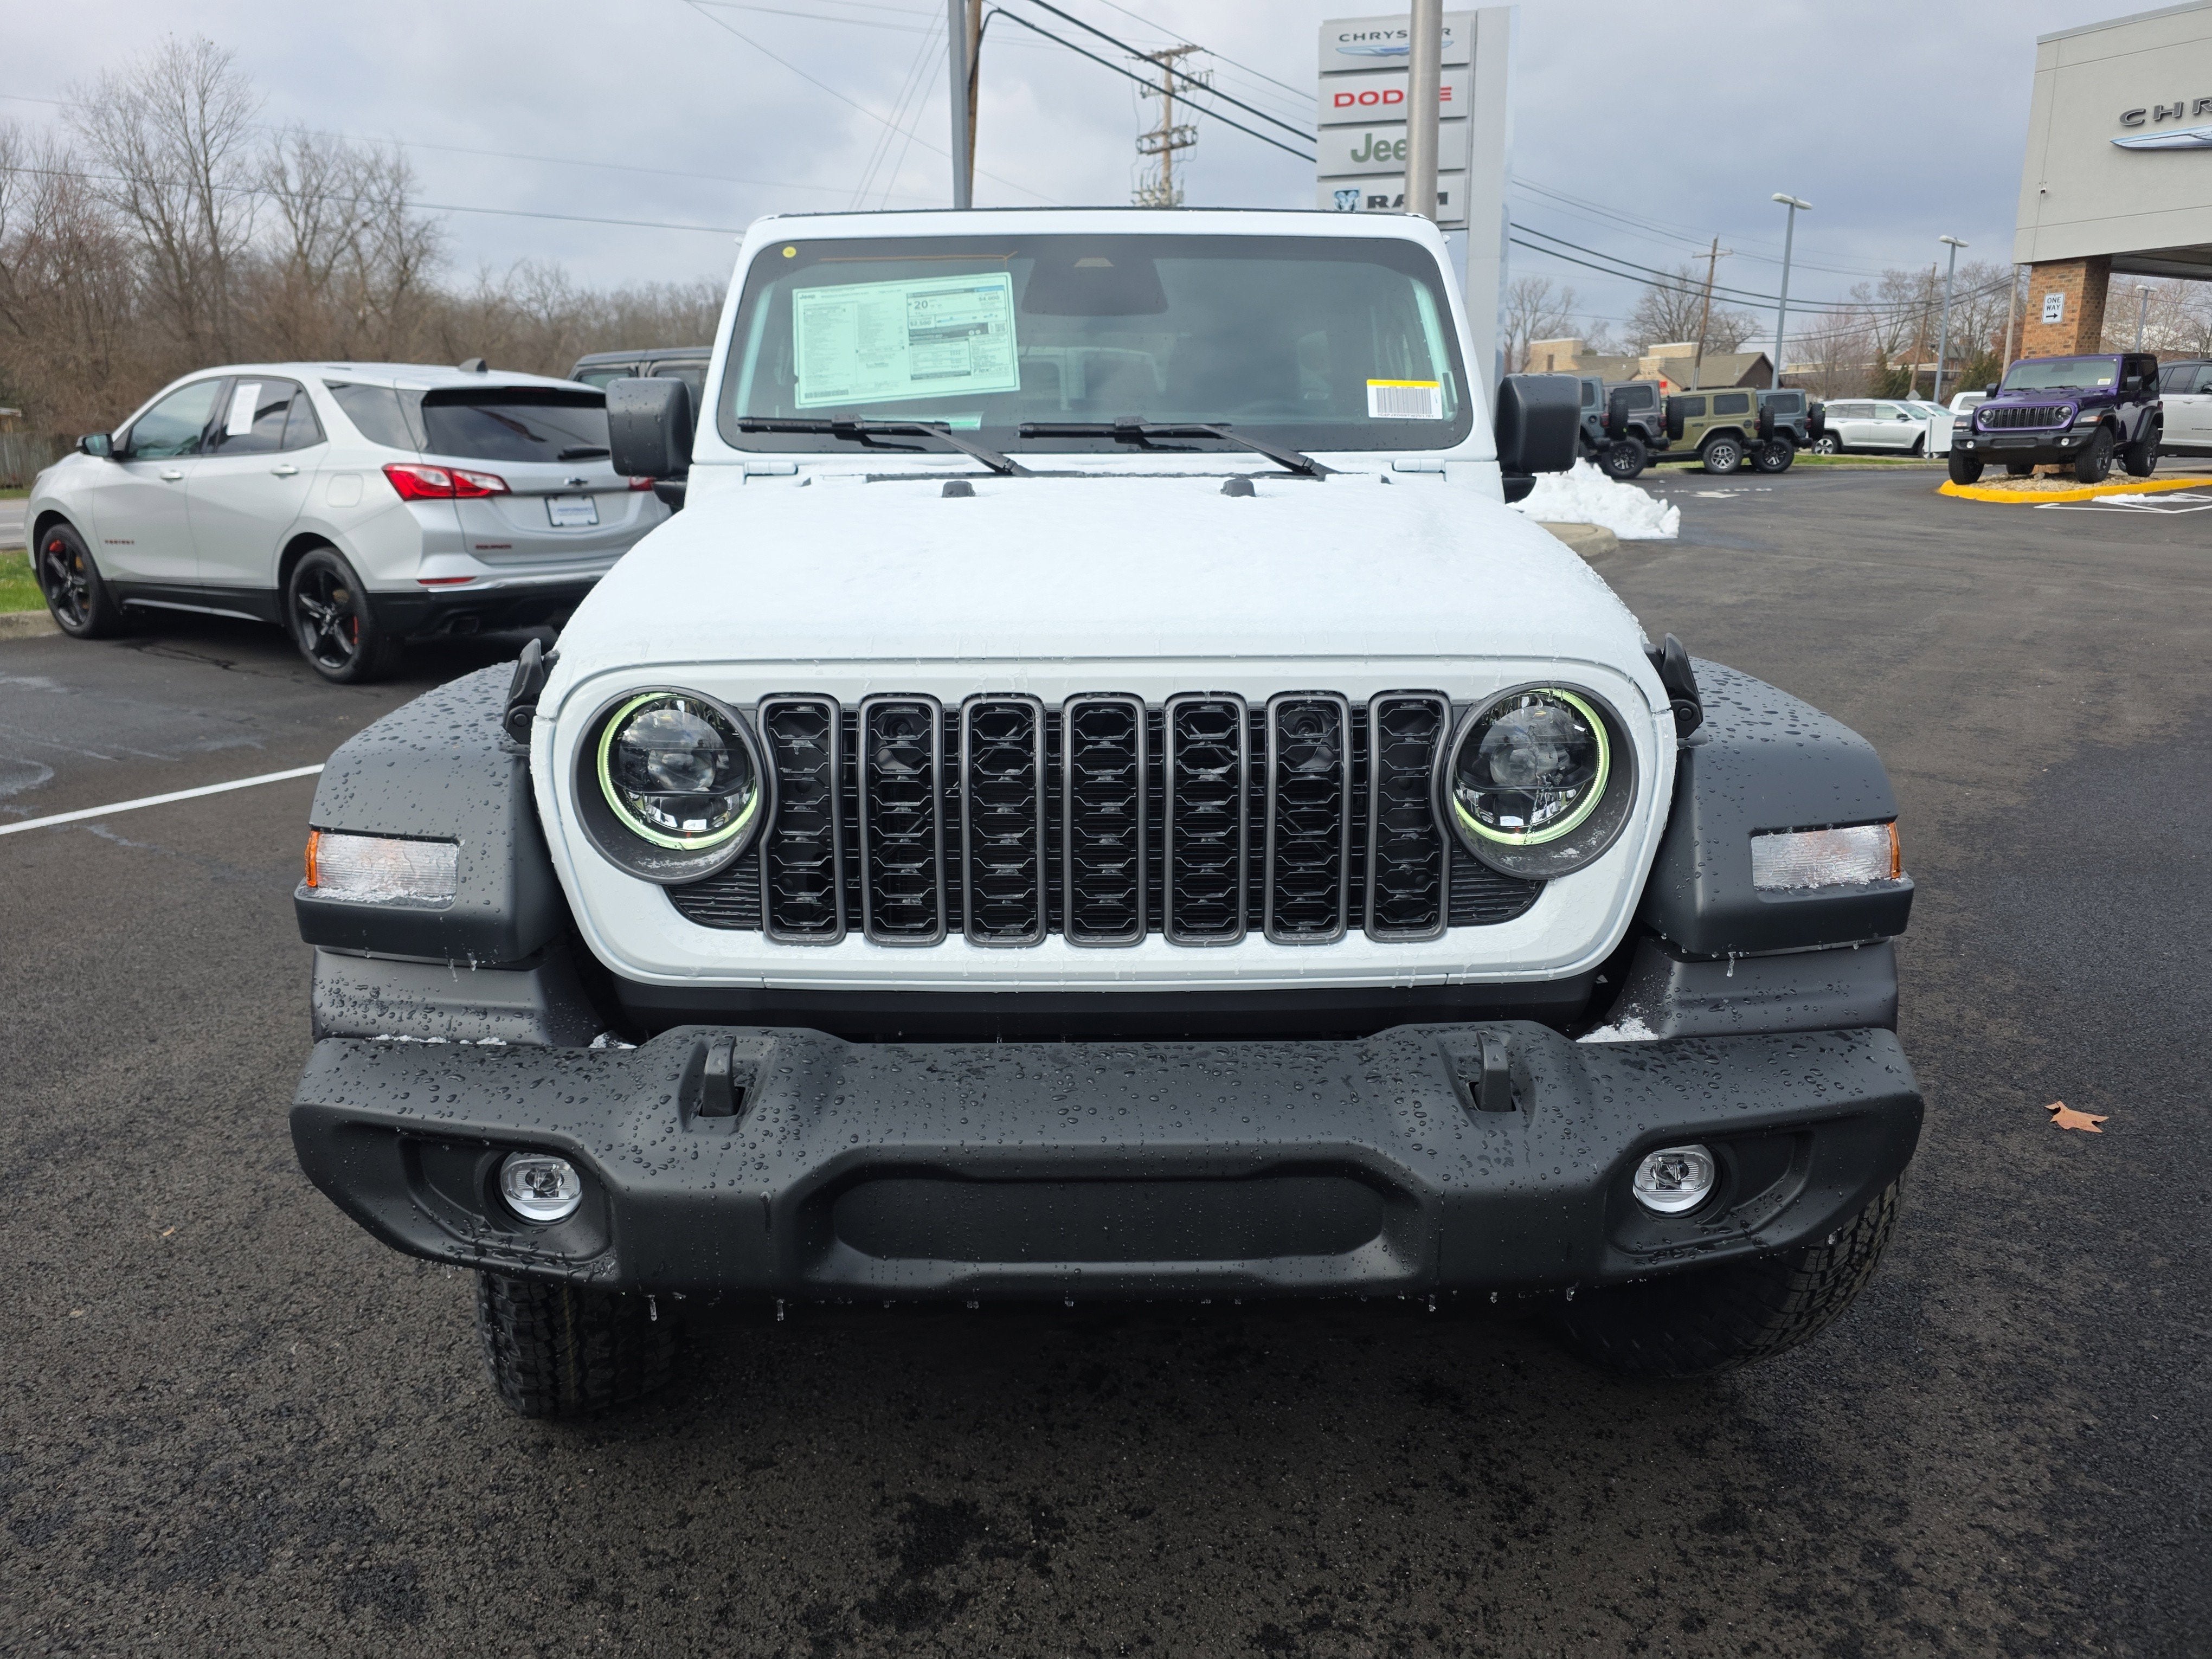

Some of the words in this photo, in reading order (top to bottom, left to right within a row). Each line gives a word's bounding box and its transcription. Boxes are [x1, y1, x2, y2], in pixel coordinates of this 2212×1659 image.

[1339, 28, 1451, 42] CHRYSR
[1334, 87, 1452, 108] DODE
[1351, 133, 1408, 163] Jee
[914, 299, 928, 310] 20
